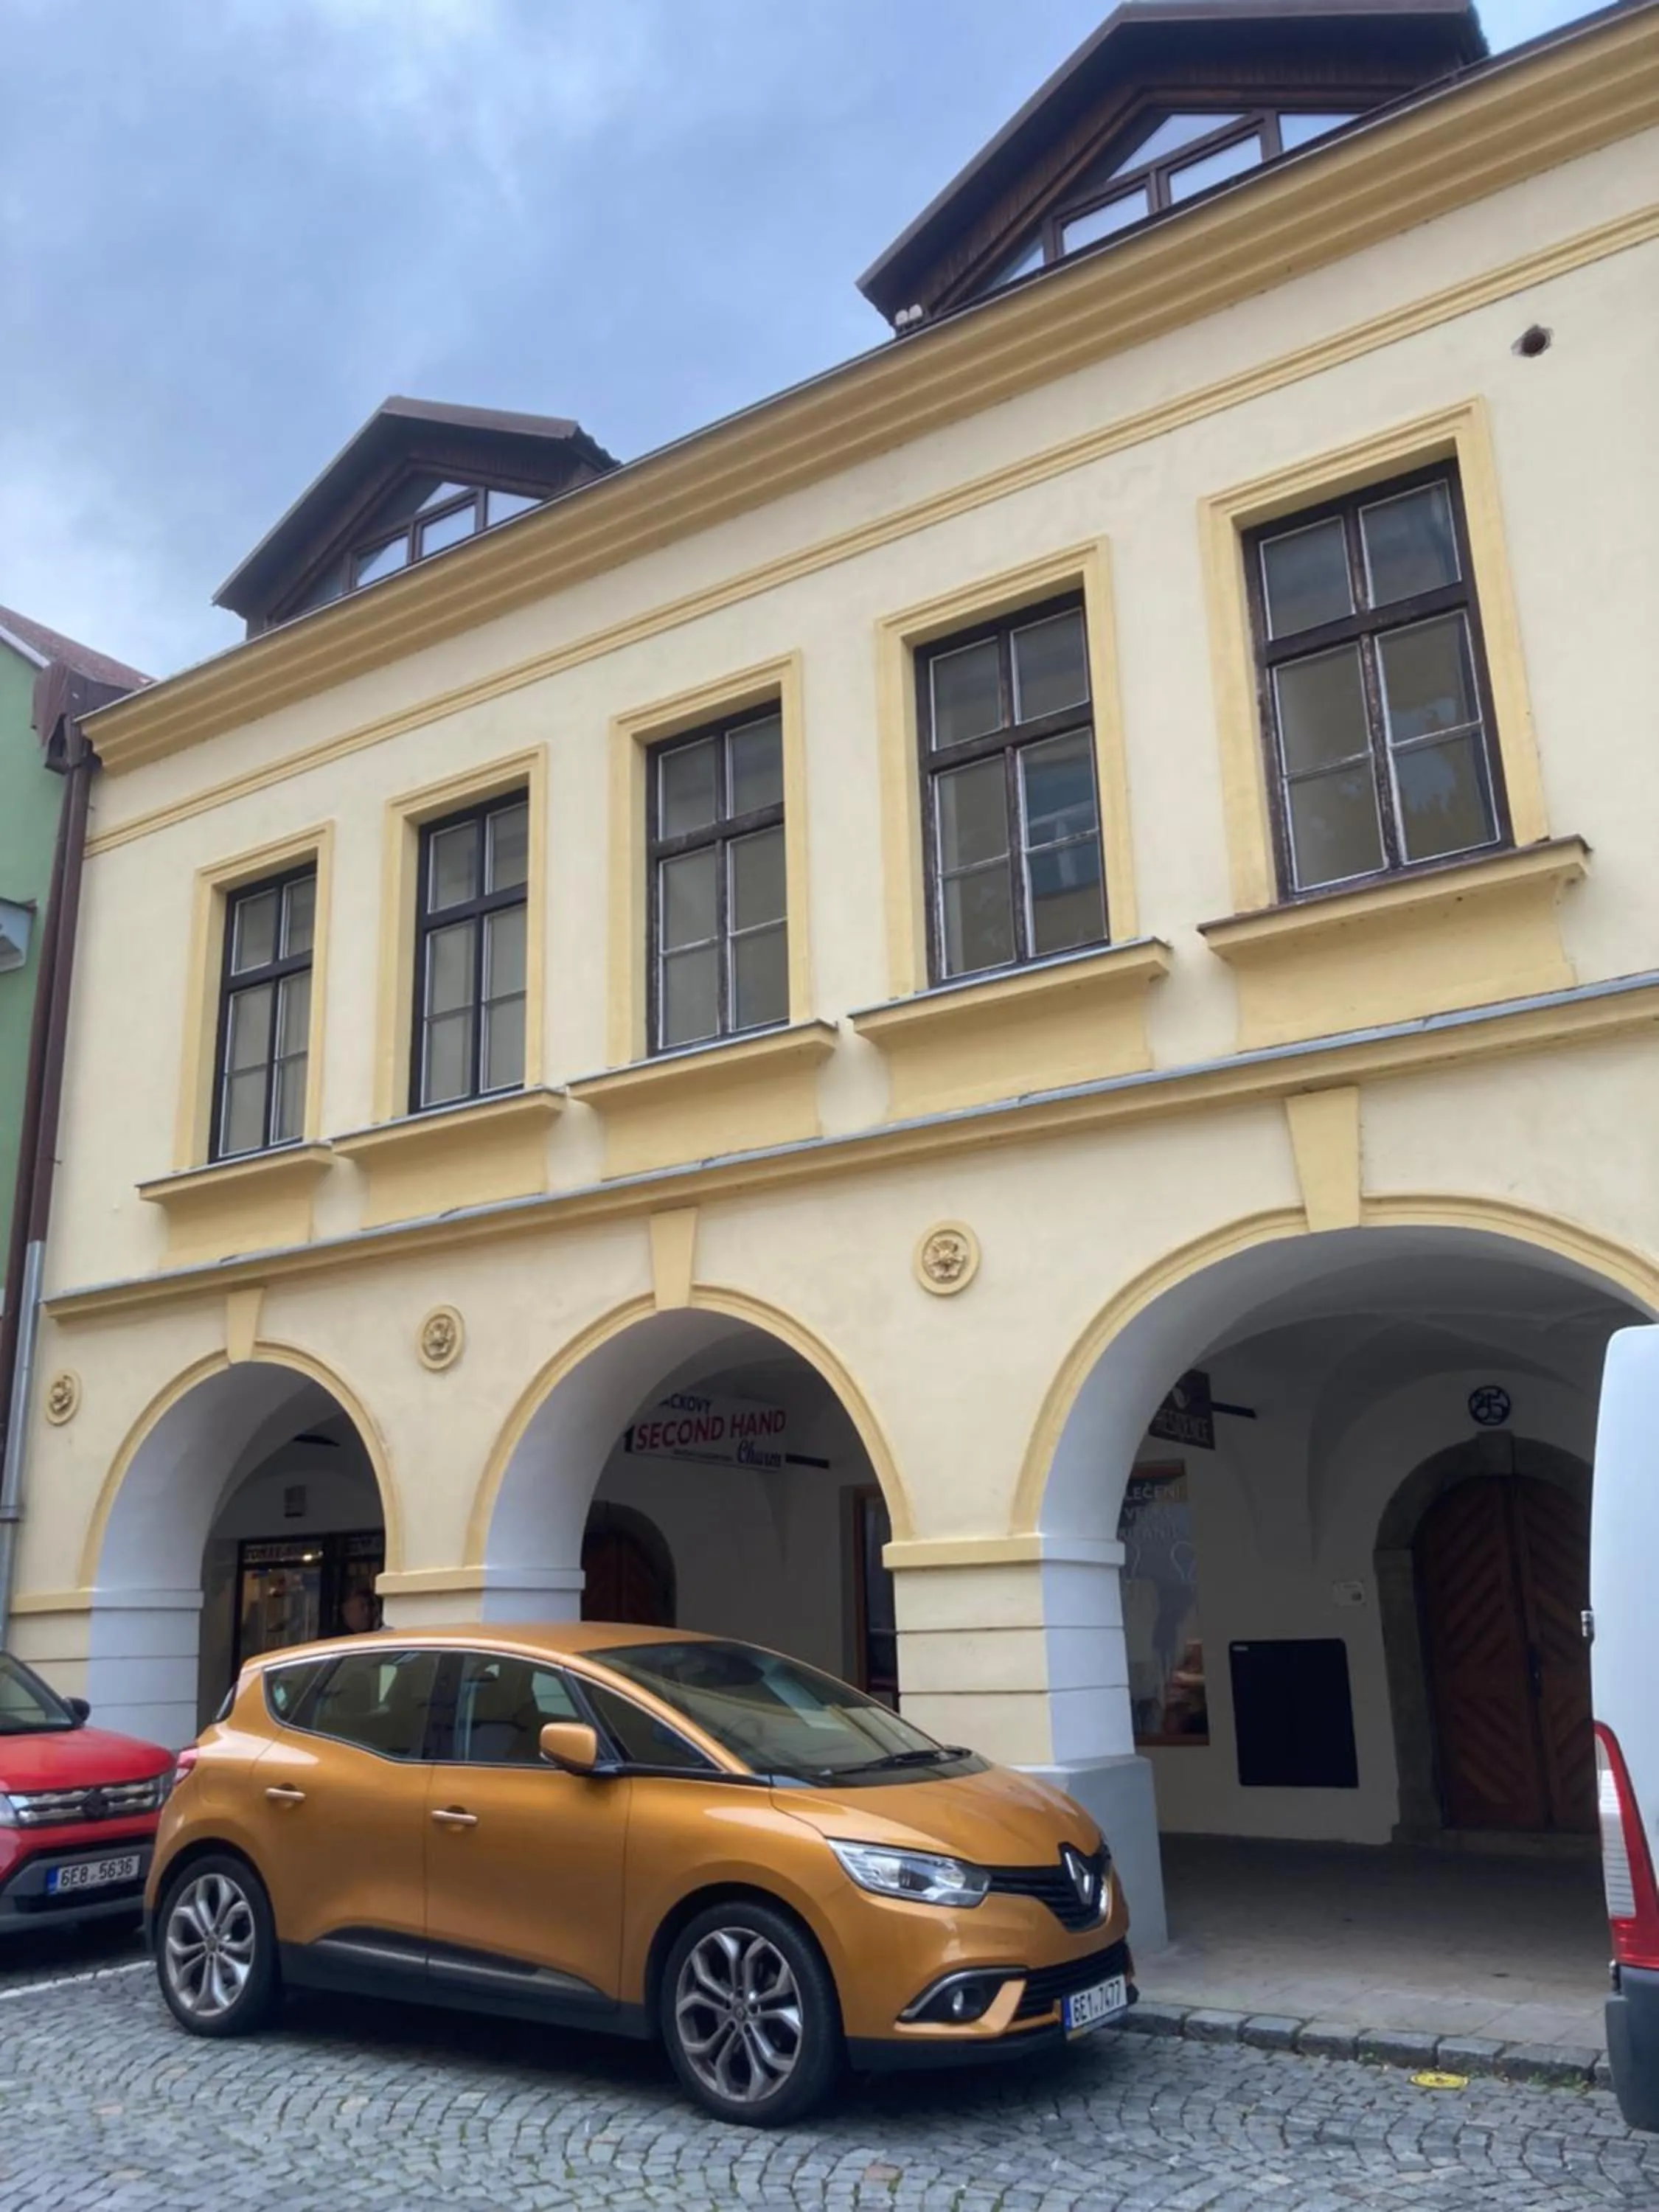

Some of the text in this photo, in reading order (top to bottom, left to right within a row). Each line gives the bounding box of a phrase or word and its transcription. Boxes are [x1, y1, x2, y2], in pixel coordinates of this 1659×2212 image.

[636, 1409, 786, 1450] SECOND HAND
[60, 1857, 133, 1887] 6E8 5636
[1074, 1993, 1093, 2023] 6E1
